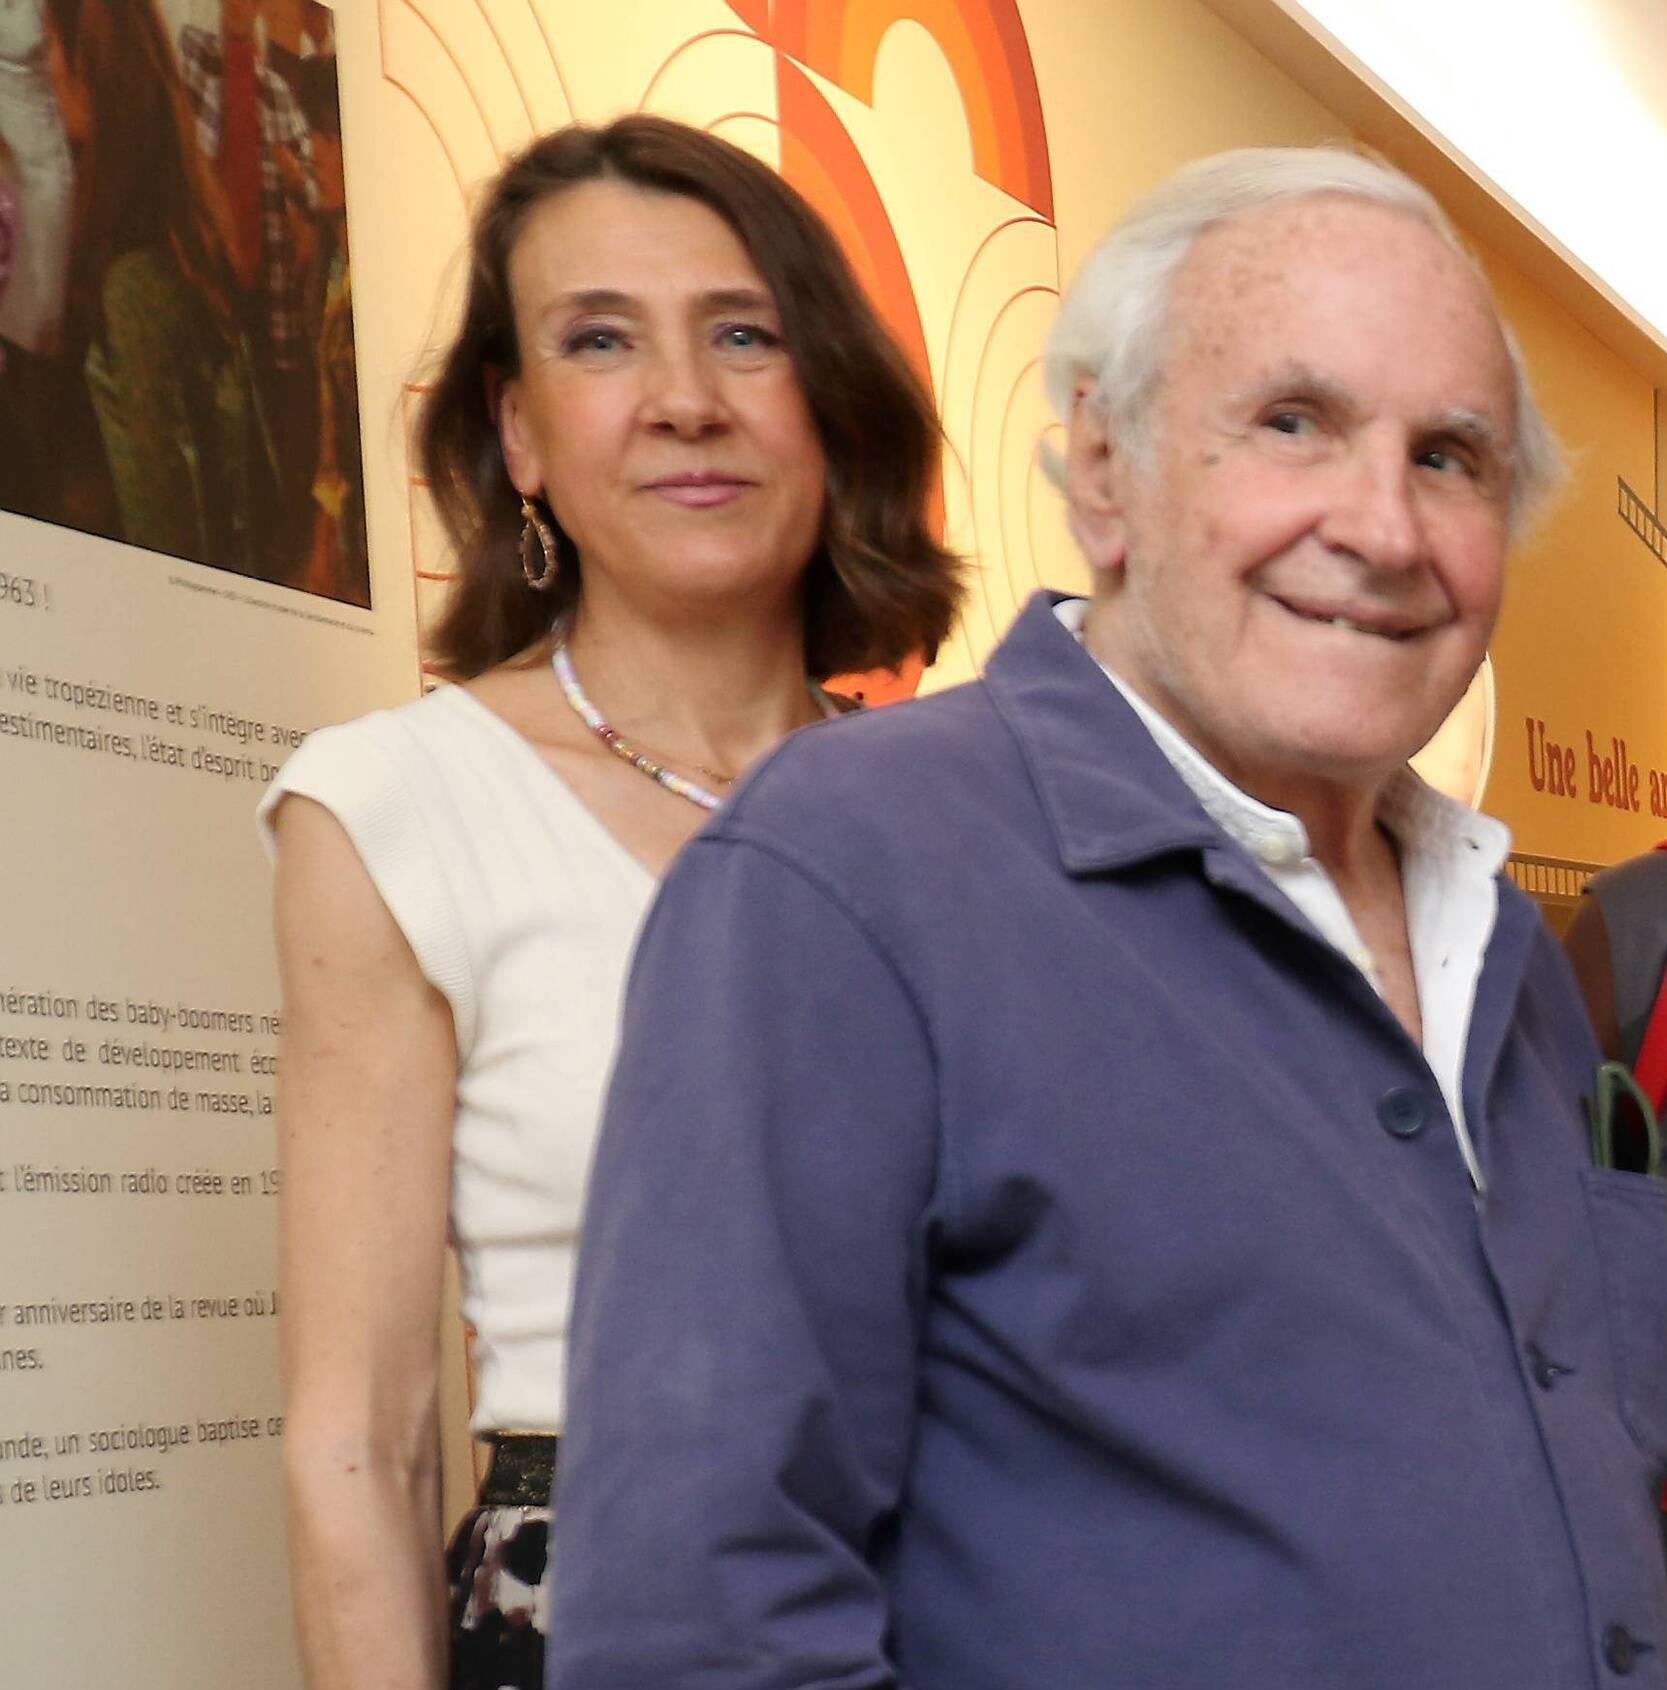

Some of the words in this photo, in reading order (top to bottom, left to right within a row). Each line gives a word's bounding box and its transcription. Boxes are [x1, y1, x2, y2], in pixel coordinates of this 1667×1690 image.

[7, 667, 37, 695] vie
[45, 676, 159, 720] tropézienne
[166, 703, 184, 728] et
[190, 705, 265, 746] s'intègre
[140, 733, 186, 768] l'état
[191, 746, 253, 783] d'esprit
[1525, 717, 1576, 798] Une
[1586, 729, 1640, 813] belle
[87, 994, 118, 1022] des
[126, 997, 253, 1033] baby-boomers
[63, 1036, 85, 1063] de
[99, 1038, 240, 1075] développement
[18, 1080, 161, 1109] consommation
[168, 1086, 189, 1111] de
[195, 1092, 254, 1117] masse,
[14, 1164, 111, 1194] l'émission
[120, 1168, 167, 1194] radio
[175, 1168, 223, 1195] créée
[230, 1177, 251, 1194] en
[14, 1296, 135, 1326] anniversaire
[141, 1295, 163, 1321] de
[168, 1294, 185, 1320] la
[191, 1297, 239, 1320] revue
[54, 1431, 79, 1455] un
[89, 1423, 190, 1454] sociologue
[196, 1415, 260, 1446] baptise
[11, 1476, 36, 1505] de
[42, 1473, 92, 1501] leurs
